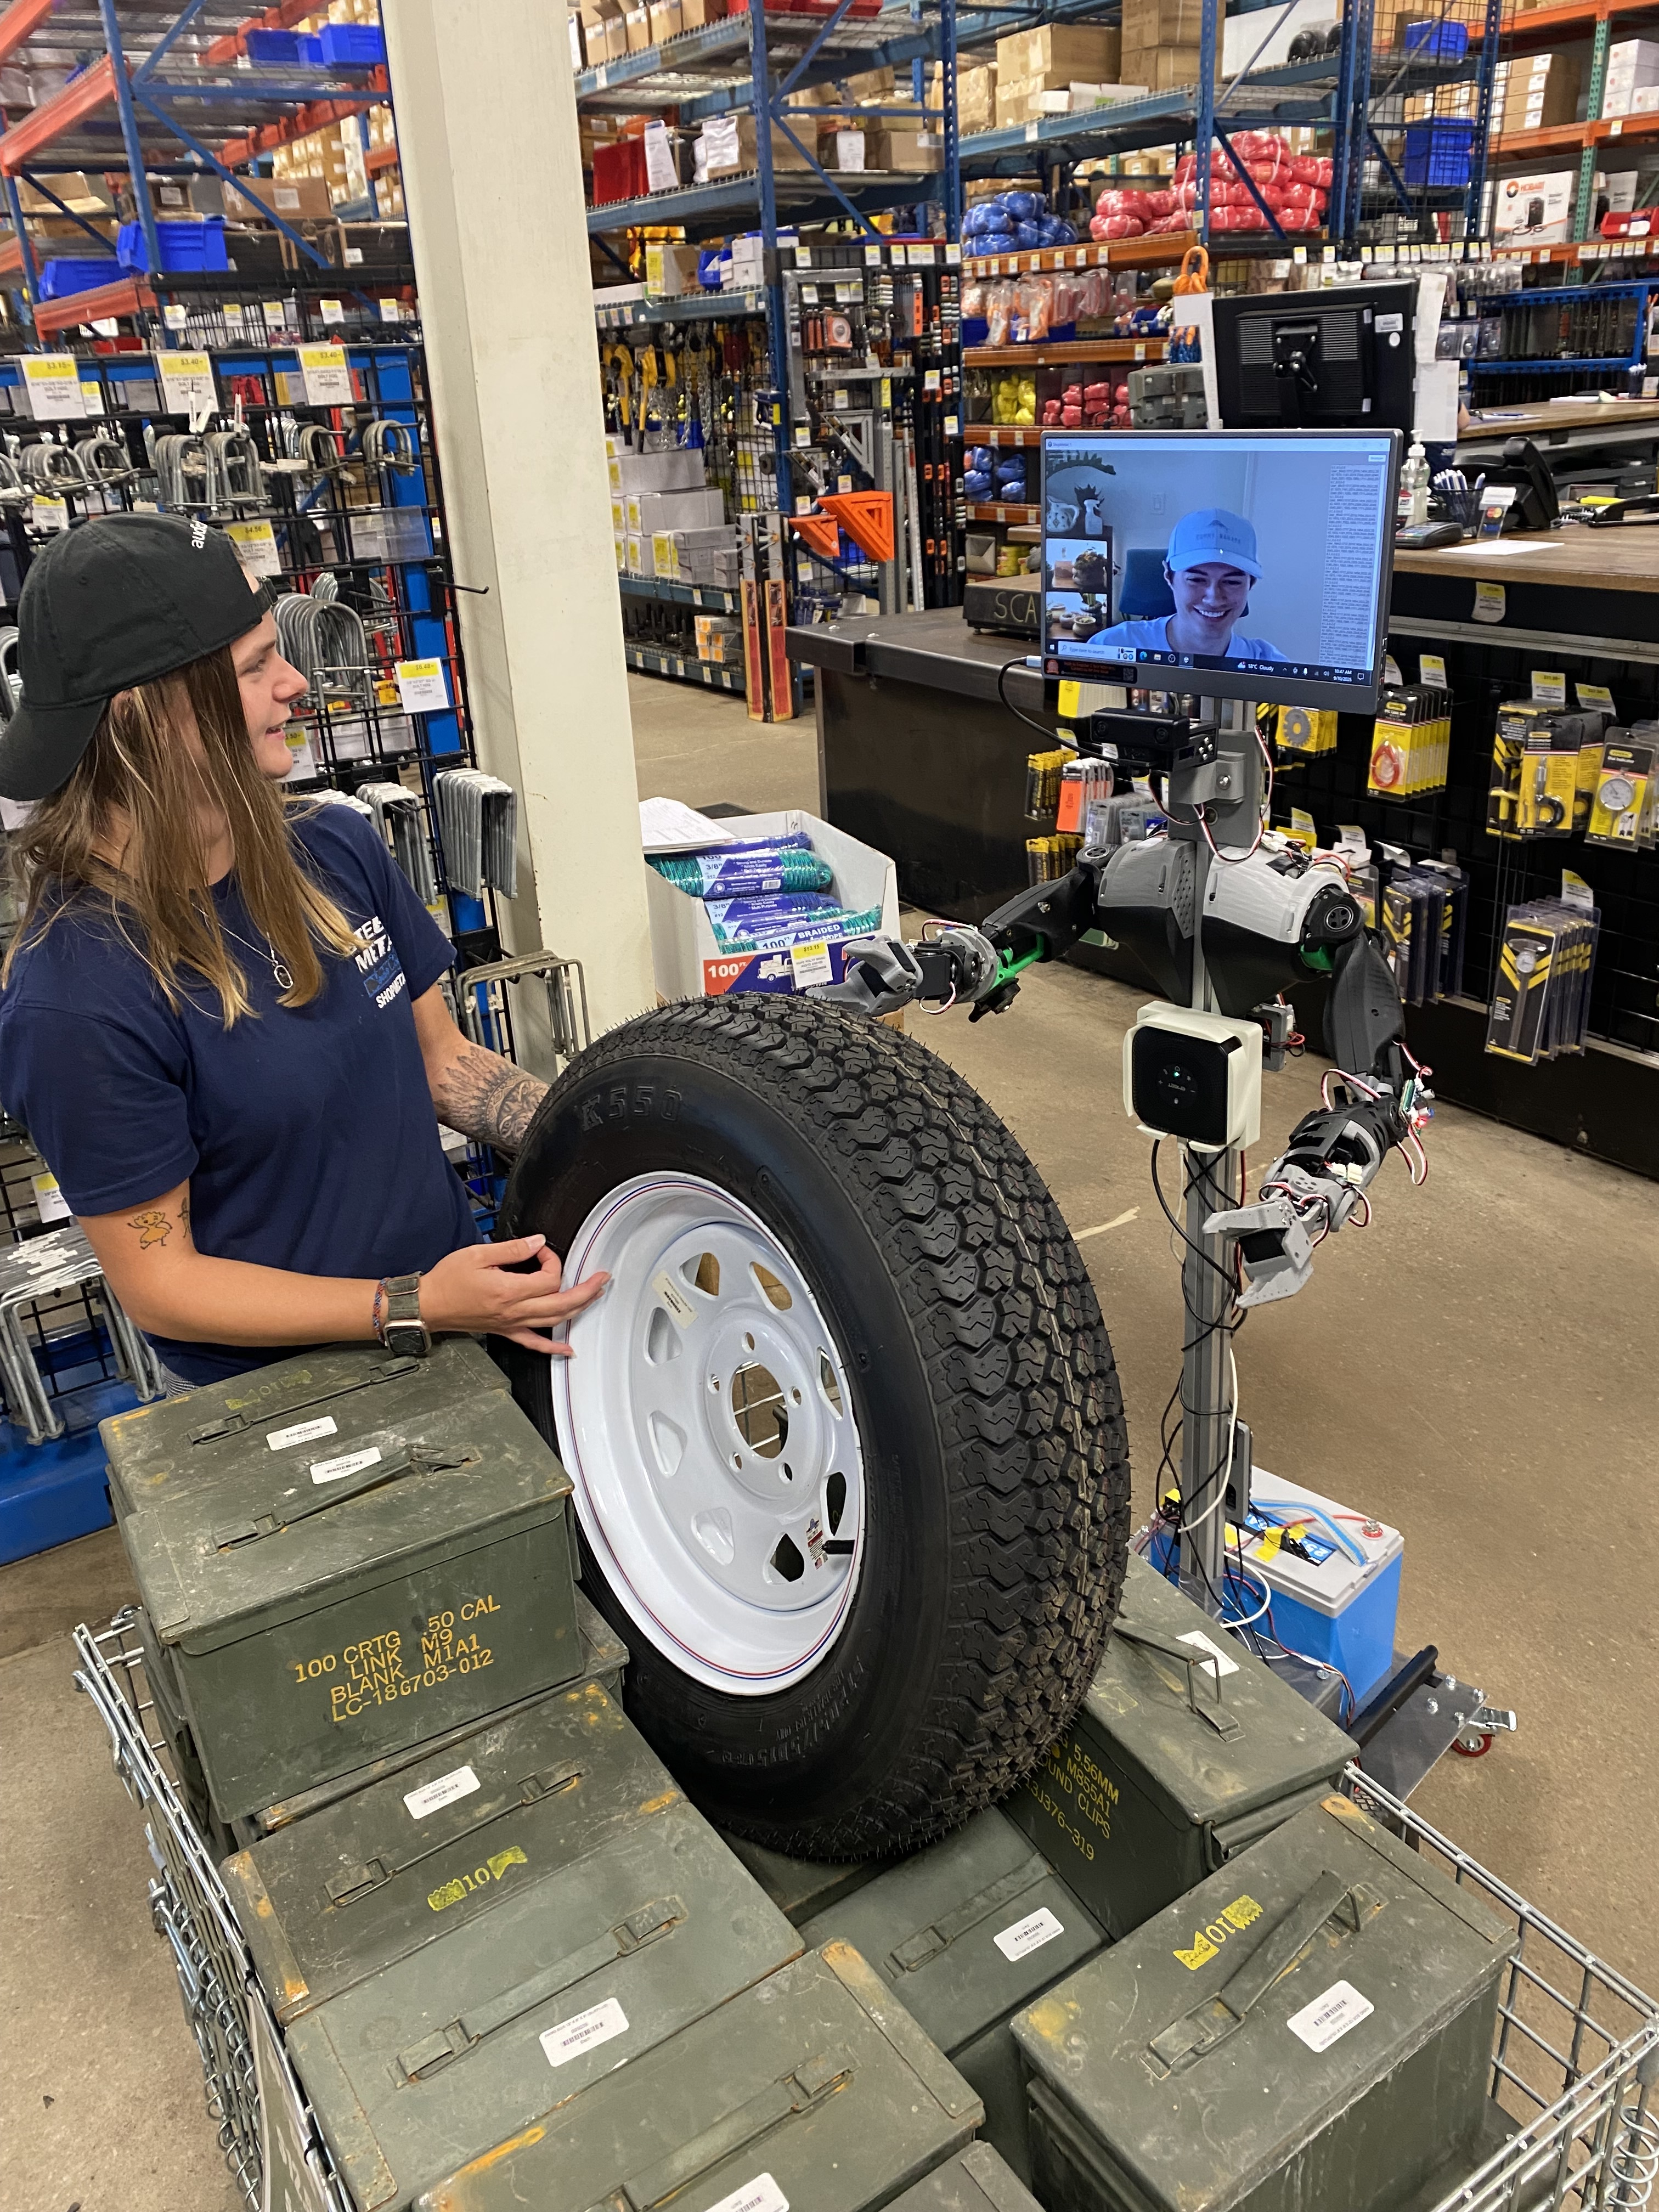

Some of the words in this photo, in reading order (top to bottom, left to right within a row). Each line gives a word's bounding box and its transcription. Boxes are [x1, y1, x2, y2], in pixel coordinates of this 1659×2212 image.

[763, 939, 786, 949] 100
[798, 924, 840, 939] BRAIDED
[708, 963, 739, 978] 100
[295, 1654, 337, 1683] 100
[343, 1630, 401, 1664] CRTG
[423, 1611, 454, 1637] .50
[460, 1594, 501, 1621] CAL
[350, 1646, 403, 1680] LINK
[421, 1628, 453, 1653] M9
[330, 1662, 405, 1705] BLANK
[424, 1633, 481, 1669] M1A1
[1041, 1755, 1073, 1793] OUND
[1077, 1792, 1110, 1839] CLIPS
[1066, 1756, 1110, 1818] M855A1
[1074, 1742, 1120, 1805] 5.56MM
[462, 1867, 490, 1891] 10
[1205, 1917, 1236, 1943] 10
